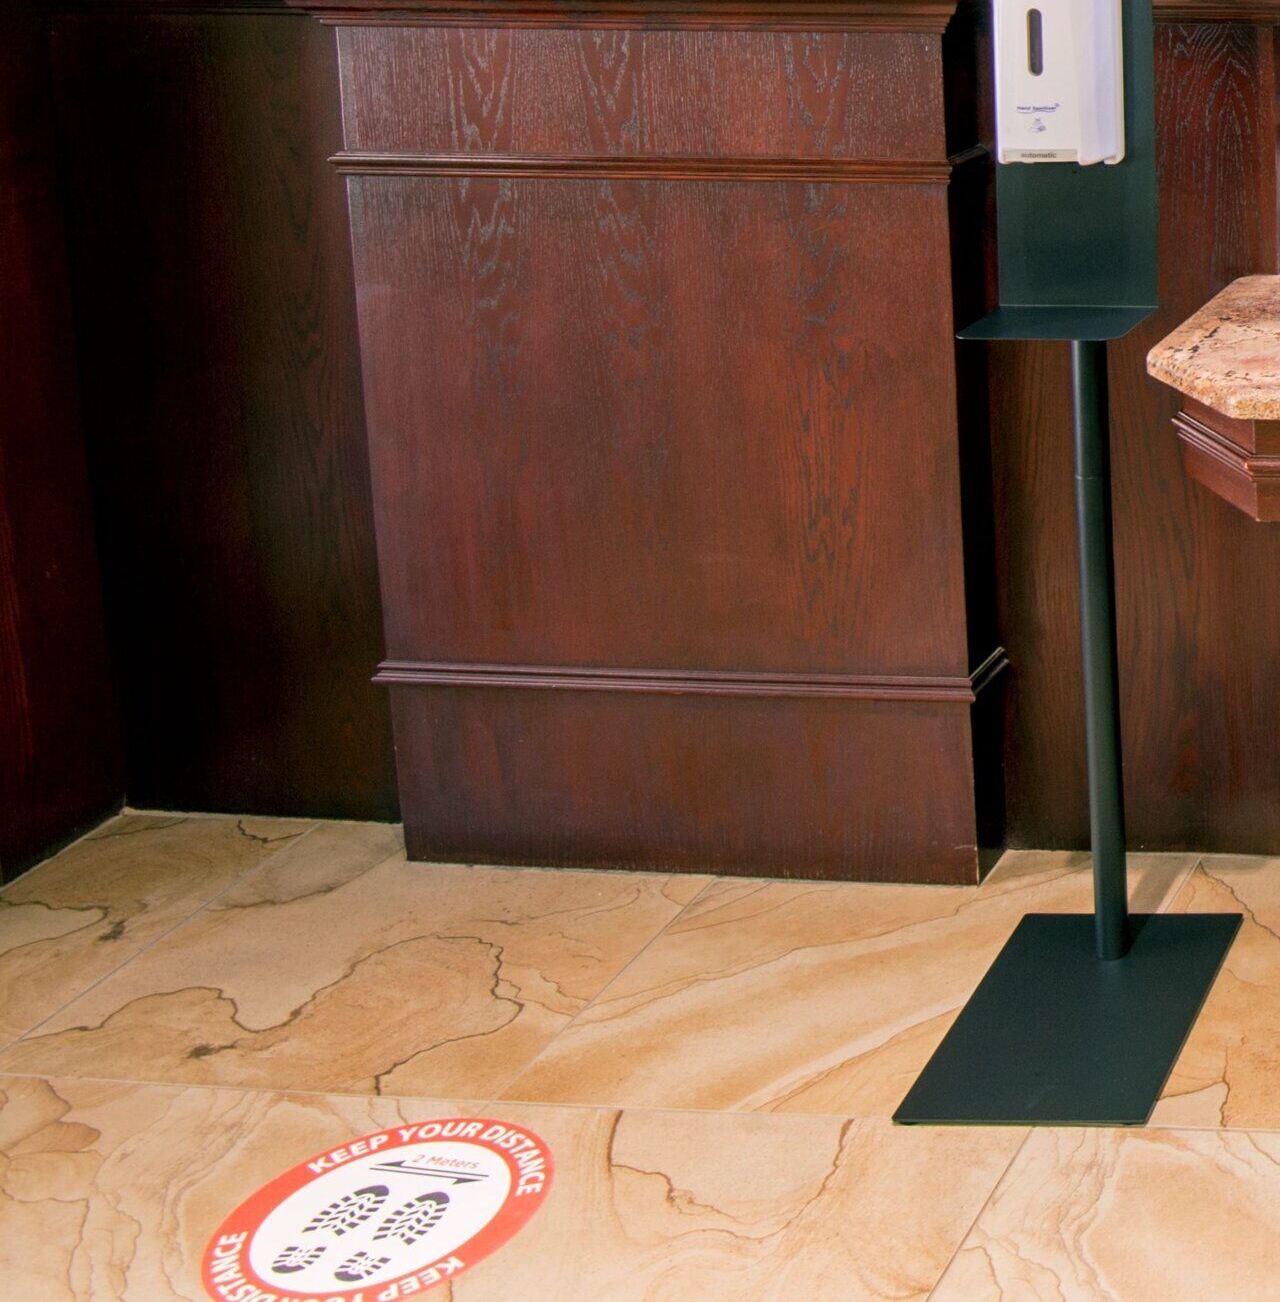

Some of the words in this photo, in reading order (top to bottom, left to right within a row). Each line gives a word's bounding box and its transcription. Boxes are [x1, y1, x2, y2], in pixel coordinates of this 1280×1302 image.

[307, 1134, 389, 1174] KEEP
[398, 1122, 484, 1143] YOUR
[479, 1124, 547, 1198] DISTANCE
[412, 1154, 426, 1164] 2
[427, 1155, 480, 1170] Meters
